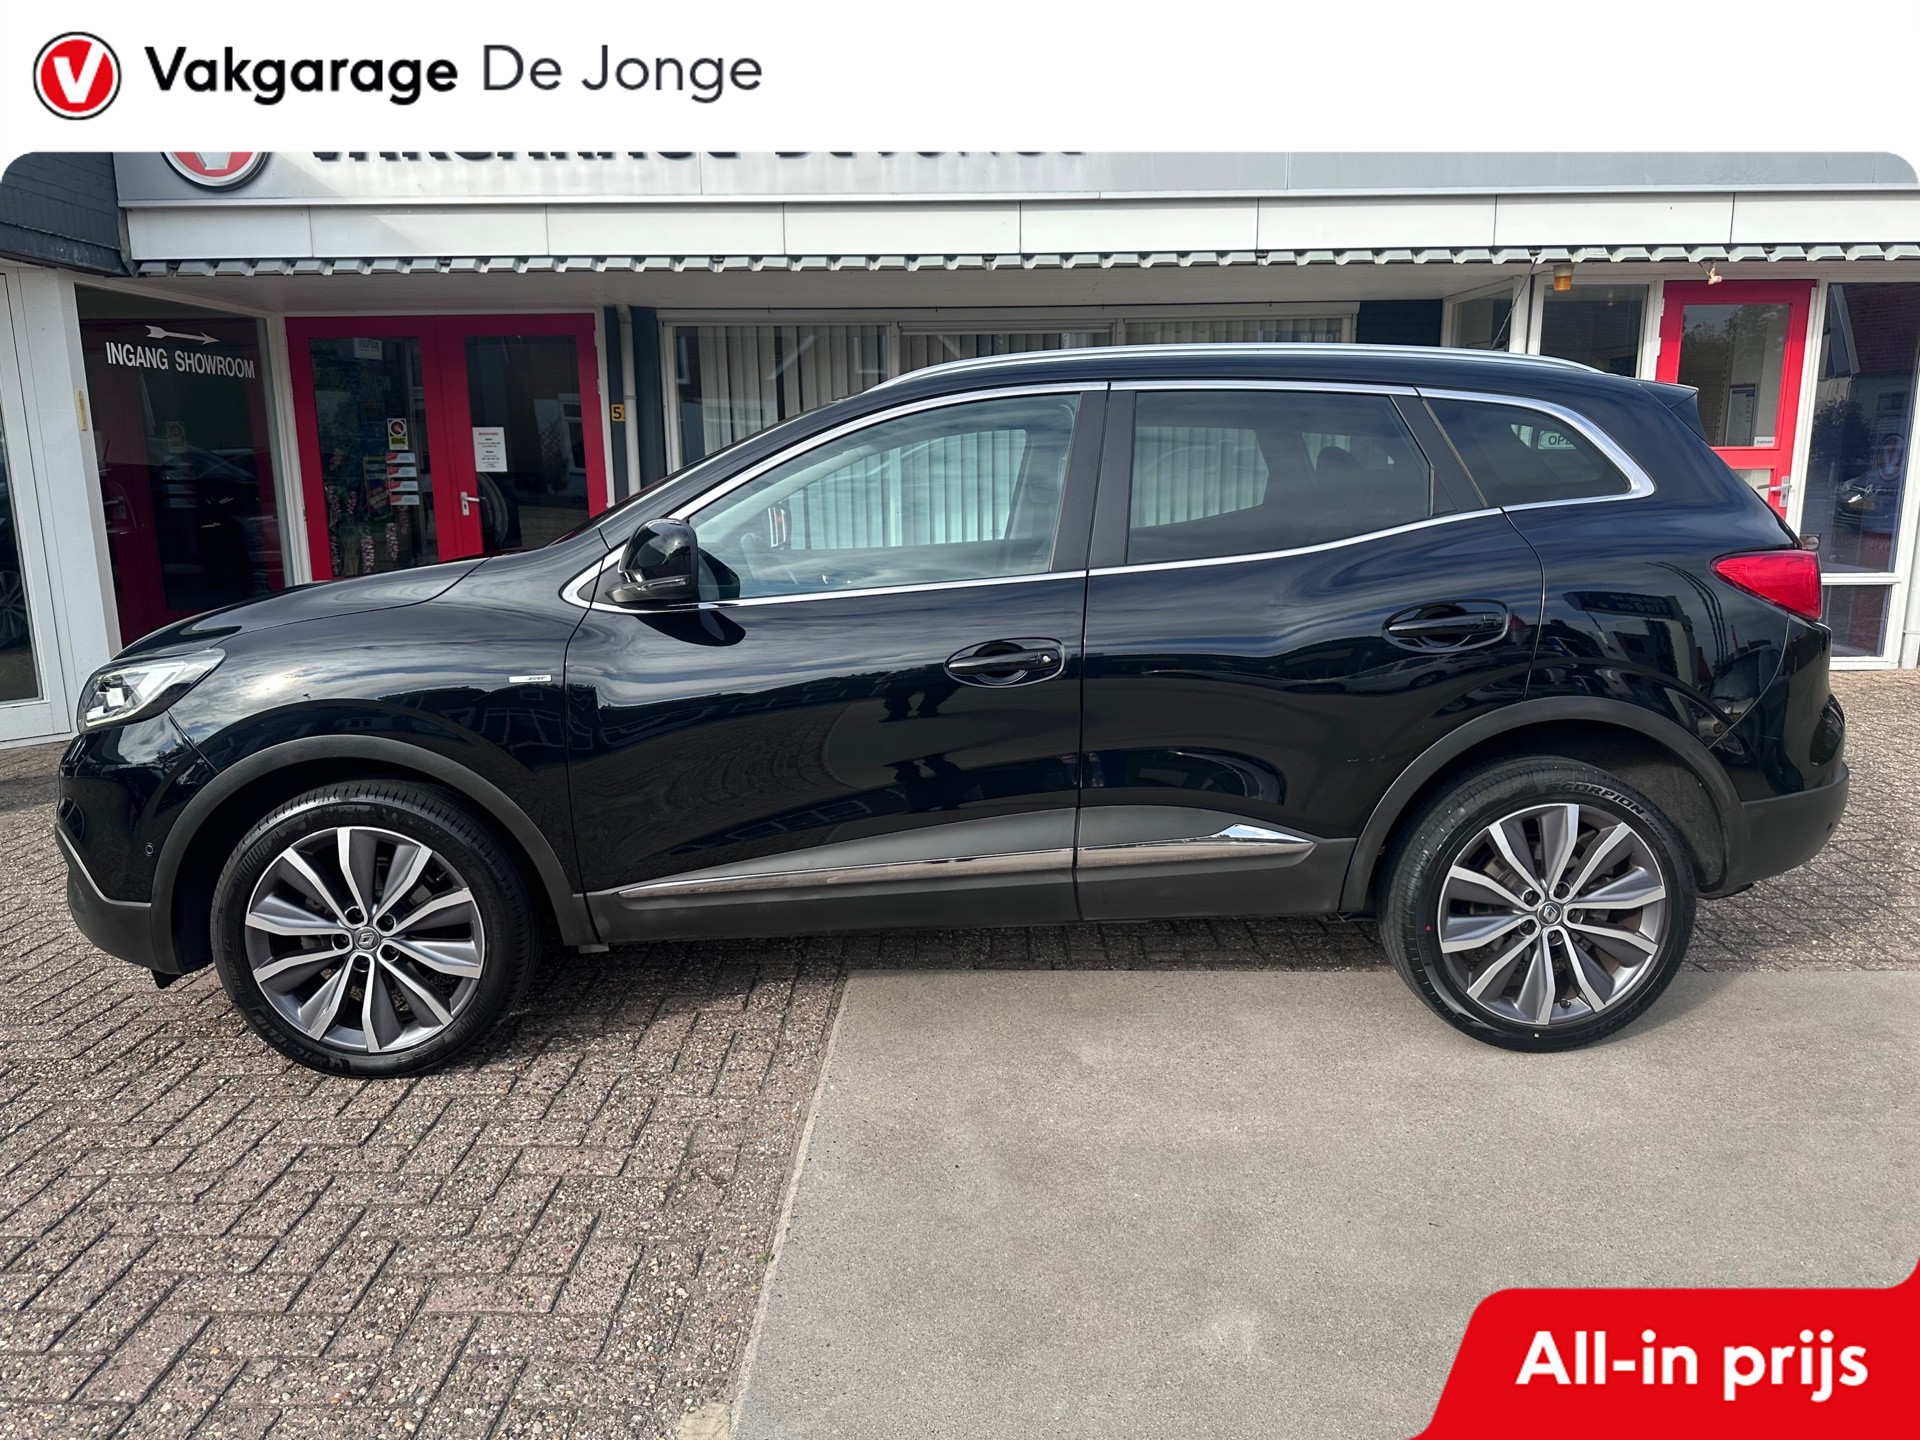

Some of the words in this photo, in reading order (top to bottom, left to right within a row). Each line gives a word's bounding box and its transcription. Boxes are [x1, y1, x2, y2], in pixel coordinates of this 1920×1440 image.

[105, 341, 169, 370] INGANG
[174, 350, 255, 379] SHOWROOM
[613, 406, 625, 420] 5
[1545, 781, 1646, 815] SCORPION
